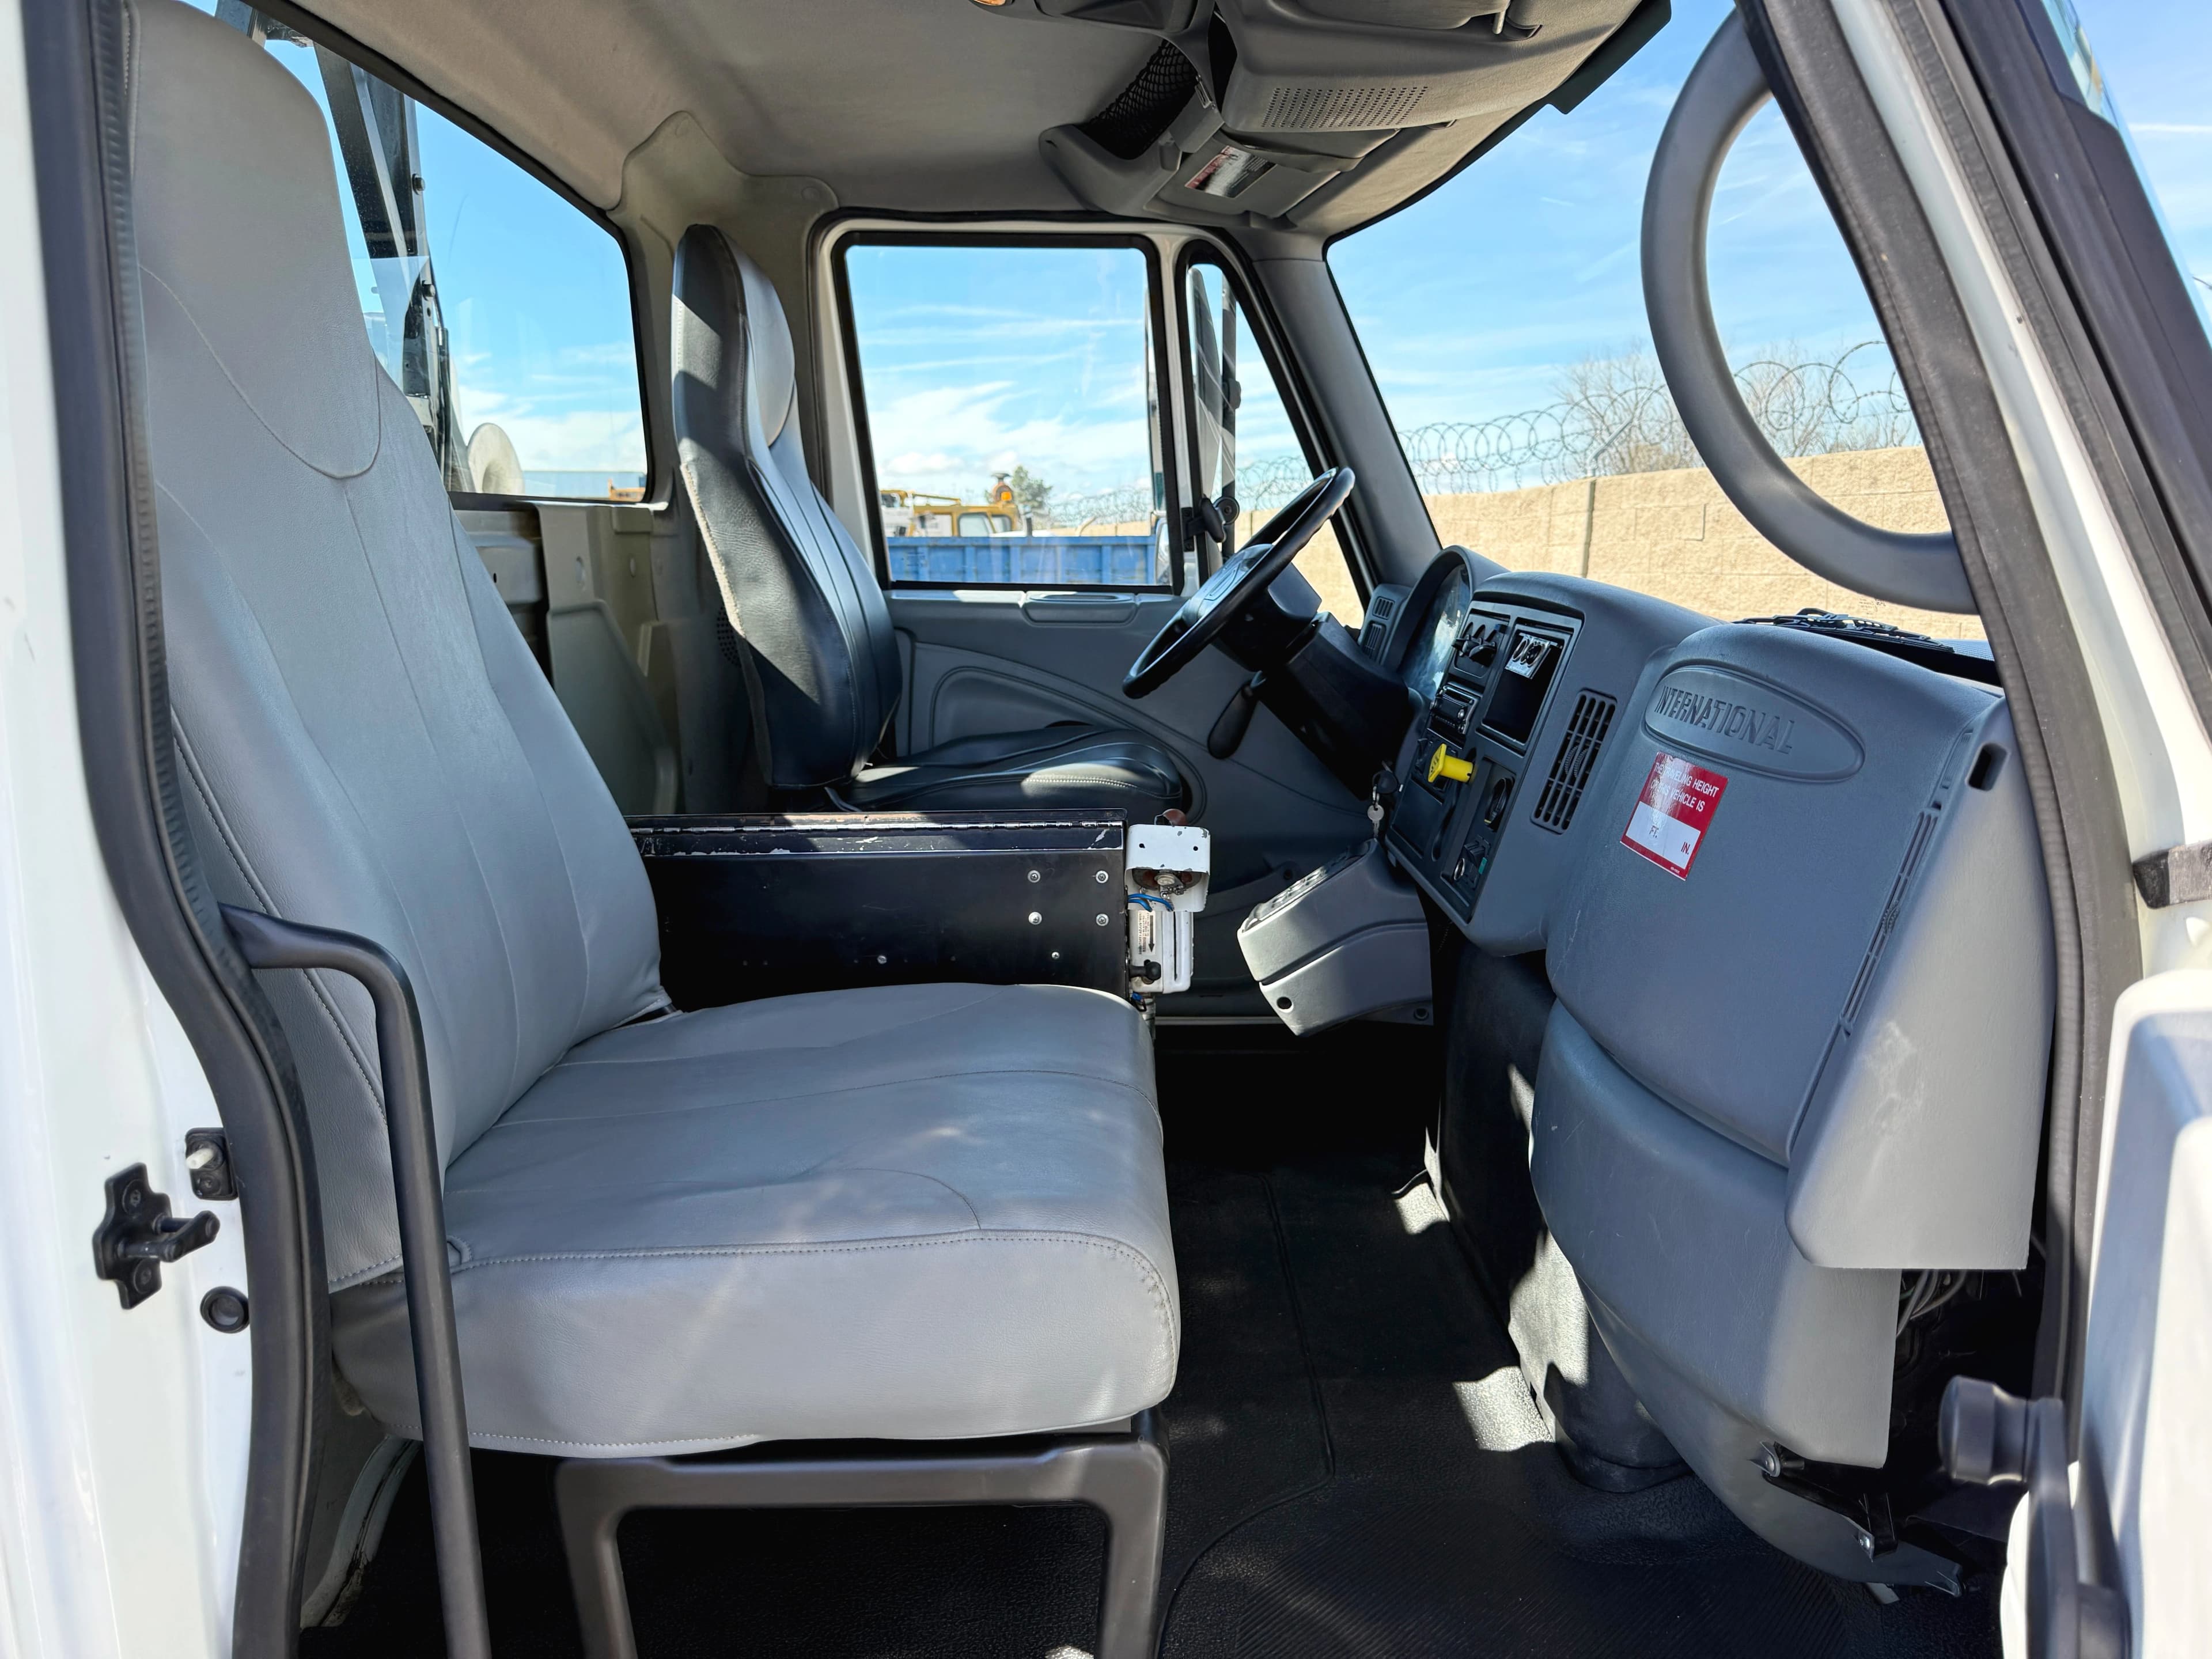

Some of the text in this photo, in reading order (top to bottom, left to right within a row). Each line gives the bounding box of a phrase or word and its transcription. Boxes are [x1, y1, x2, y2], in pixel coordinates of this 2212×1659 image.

[1654, 686, 1796, 755] INTERNATIONAL
[1654, 763, 1719, 798] THE TRAVELING HEIGHT
[1658, 782, 1671, 796] THIS
[1671, 787, 1696, 809] VEHICLE
[1696, 800, 1706, 812] IS
[1649, 825, 1659, 838] FT.
[1680, 841, 1690, 855] IN.
